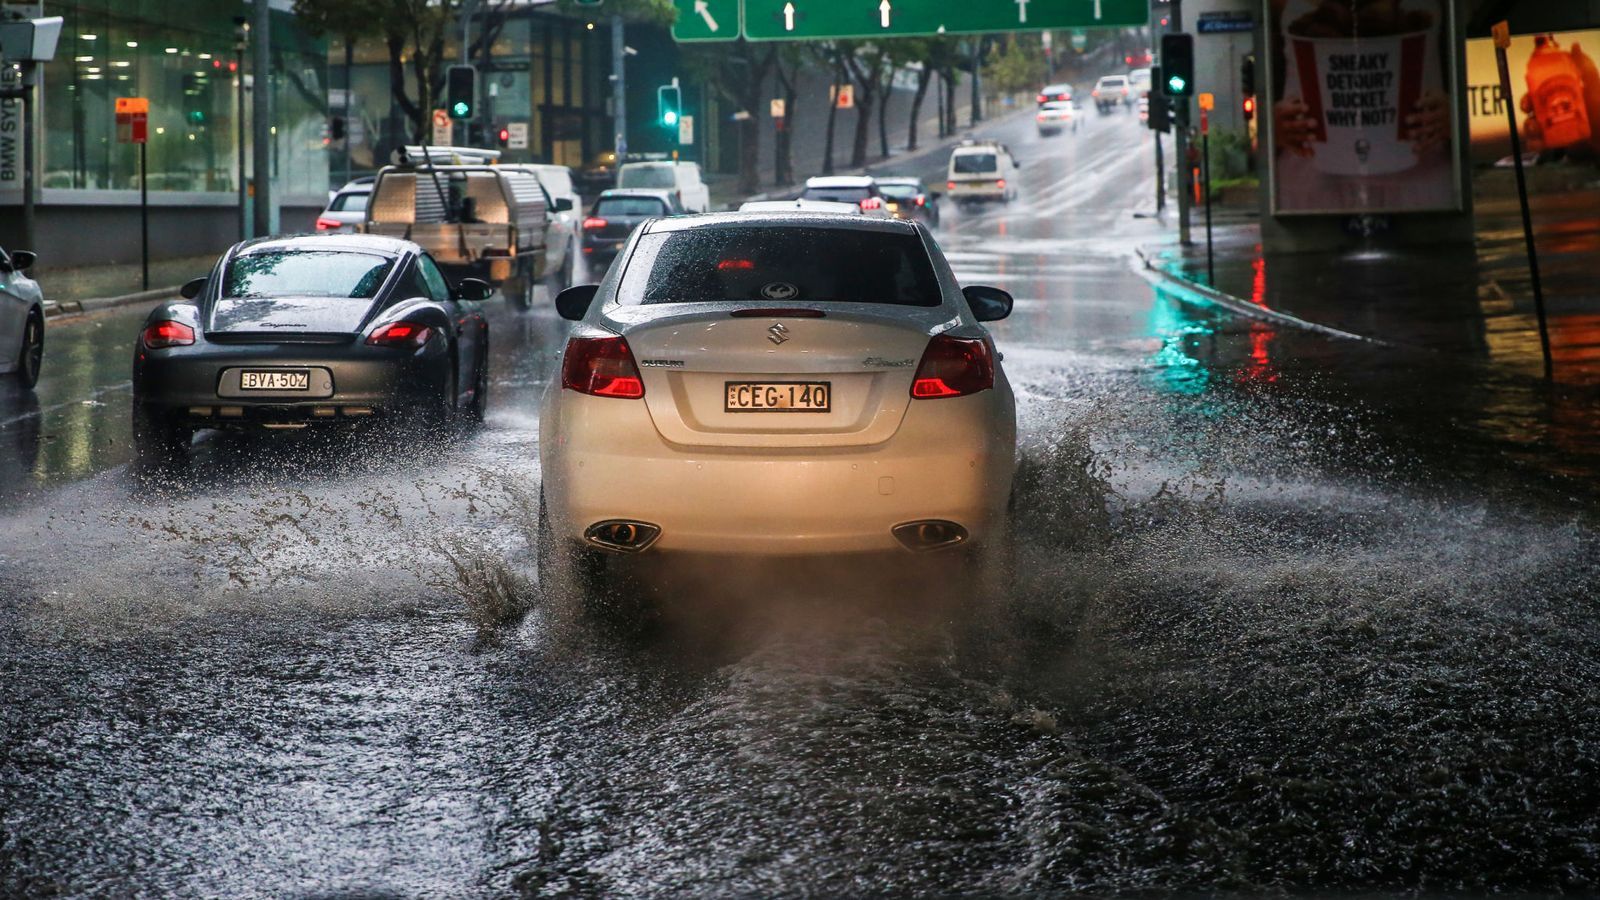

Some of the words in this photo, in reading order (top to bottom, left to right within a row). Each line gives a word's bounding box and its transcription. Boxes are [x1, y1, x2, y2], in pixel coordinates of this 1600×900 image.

[1328, 54, 1388, 71] SNEAKY
[1327, 72, 1393, 90] DETOUR?
[1326, 111, 1356, 127] WHY
[1361, 107, 1396, 125] NOT?
[1, 137, 15, 181] BMW
[641, 359, 685, 368] SUZUKI
